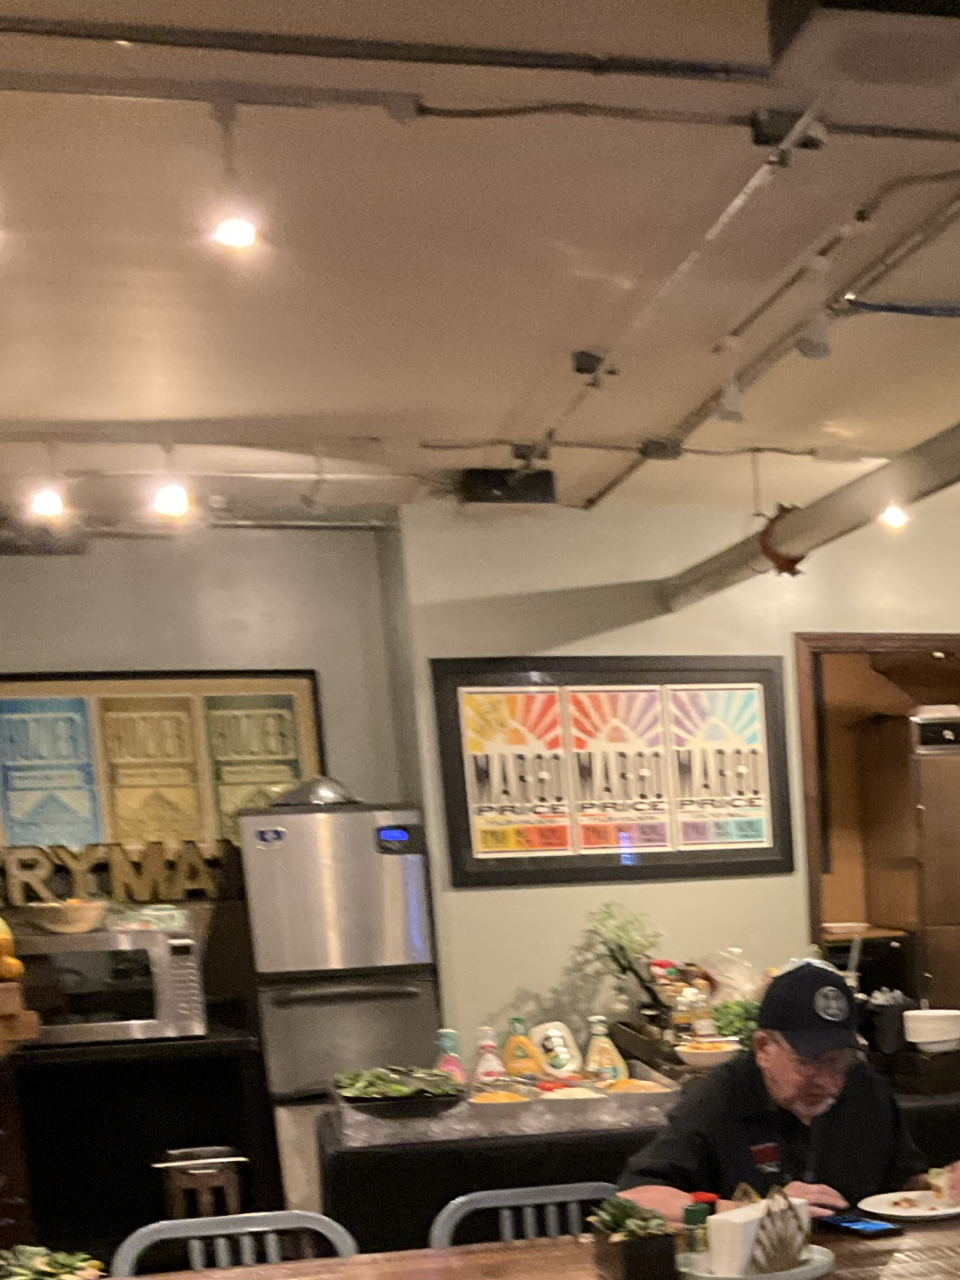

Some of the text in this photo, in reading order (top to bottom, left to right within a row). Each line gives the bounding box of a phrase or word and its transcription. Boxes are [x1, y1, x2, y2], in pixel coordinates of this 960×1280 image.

[581, 799, 666, 812] PRICE
[680, 796, 764, 809] PRICE
[477, 803, 568, 816] PRICE
